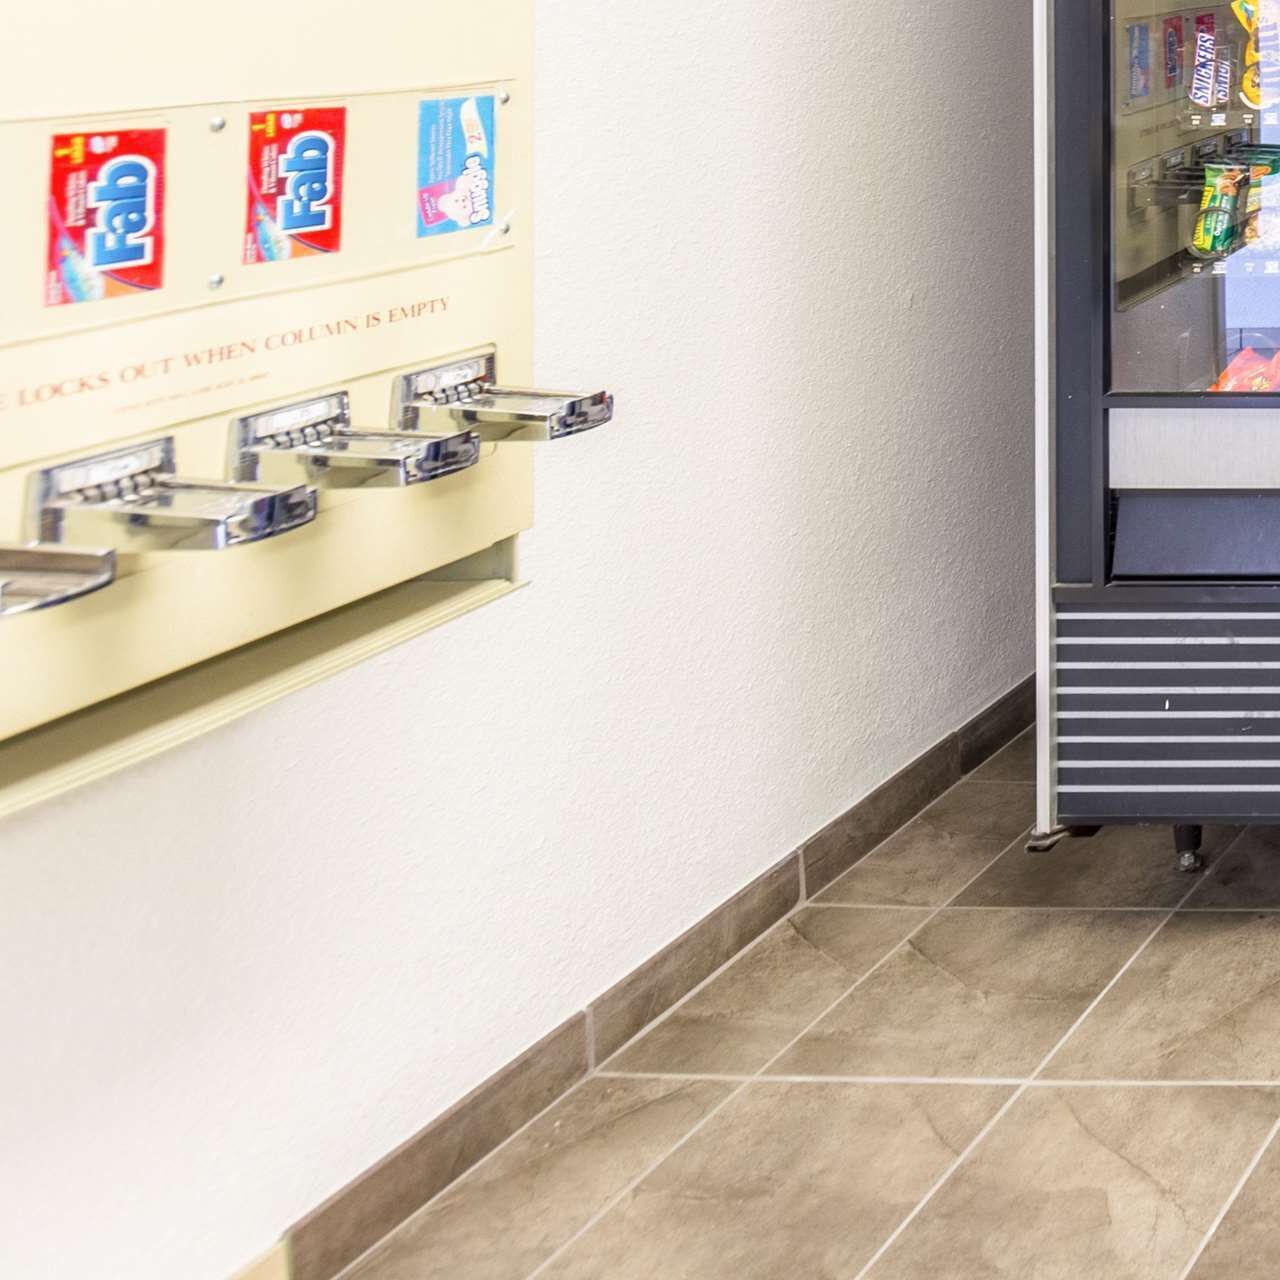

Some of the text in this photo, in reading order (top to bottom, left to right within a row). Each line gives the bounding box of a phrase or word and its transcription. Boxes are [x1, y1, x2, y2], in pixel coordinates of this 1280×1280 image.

[1193, 32, 1216, 106] SNICKERS
[87, 156, 155, 270] Fab
[280, 131, 334, 234] Fab
[461, 153, 491, 225] Snuggle
[17, 372, 111, 407] LOCKS
[119, 358, 174, 384] OUT
[184, 339, 257, 369] WHEN
[264, 317, 358, 352] COLUMN
[365, 311, 382, 329] IS
[387, 296, 451, 324] EMPTY
